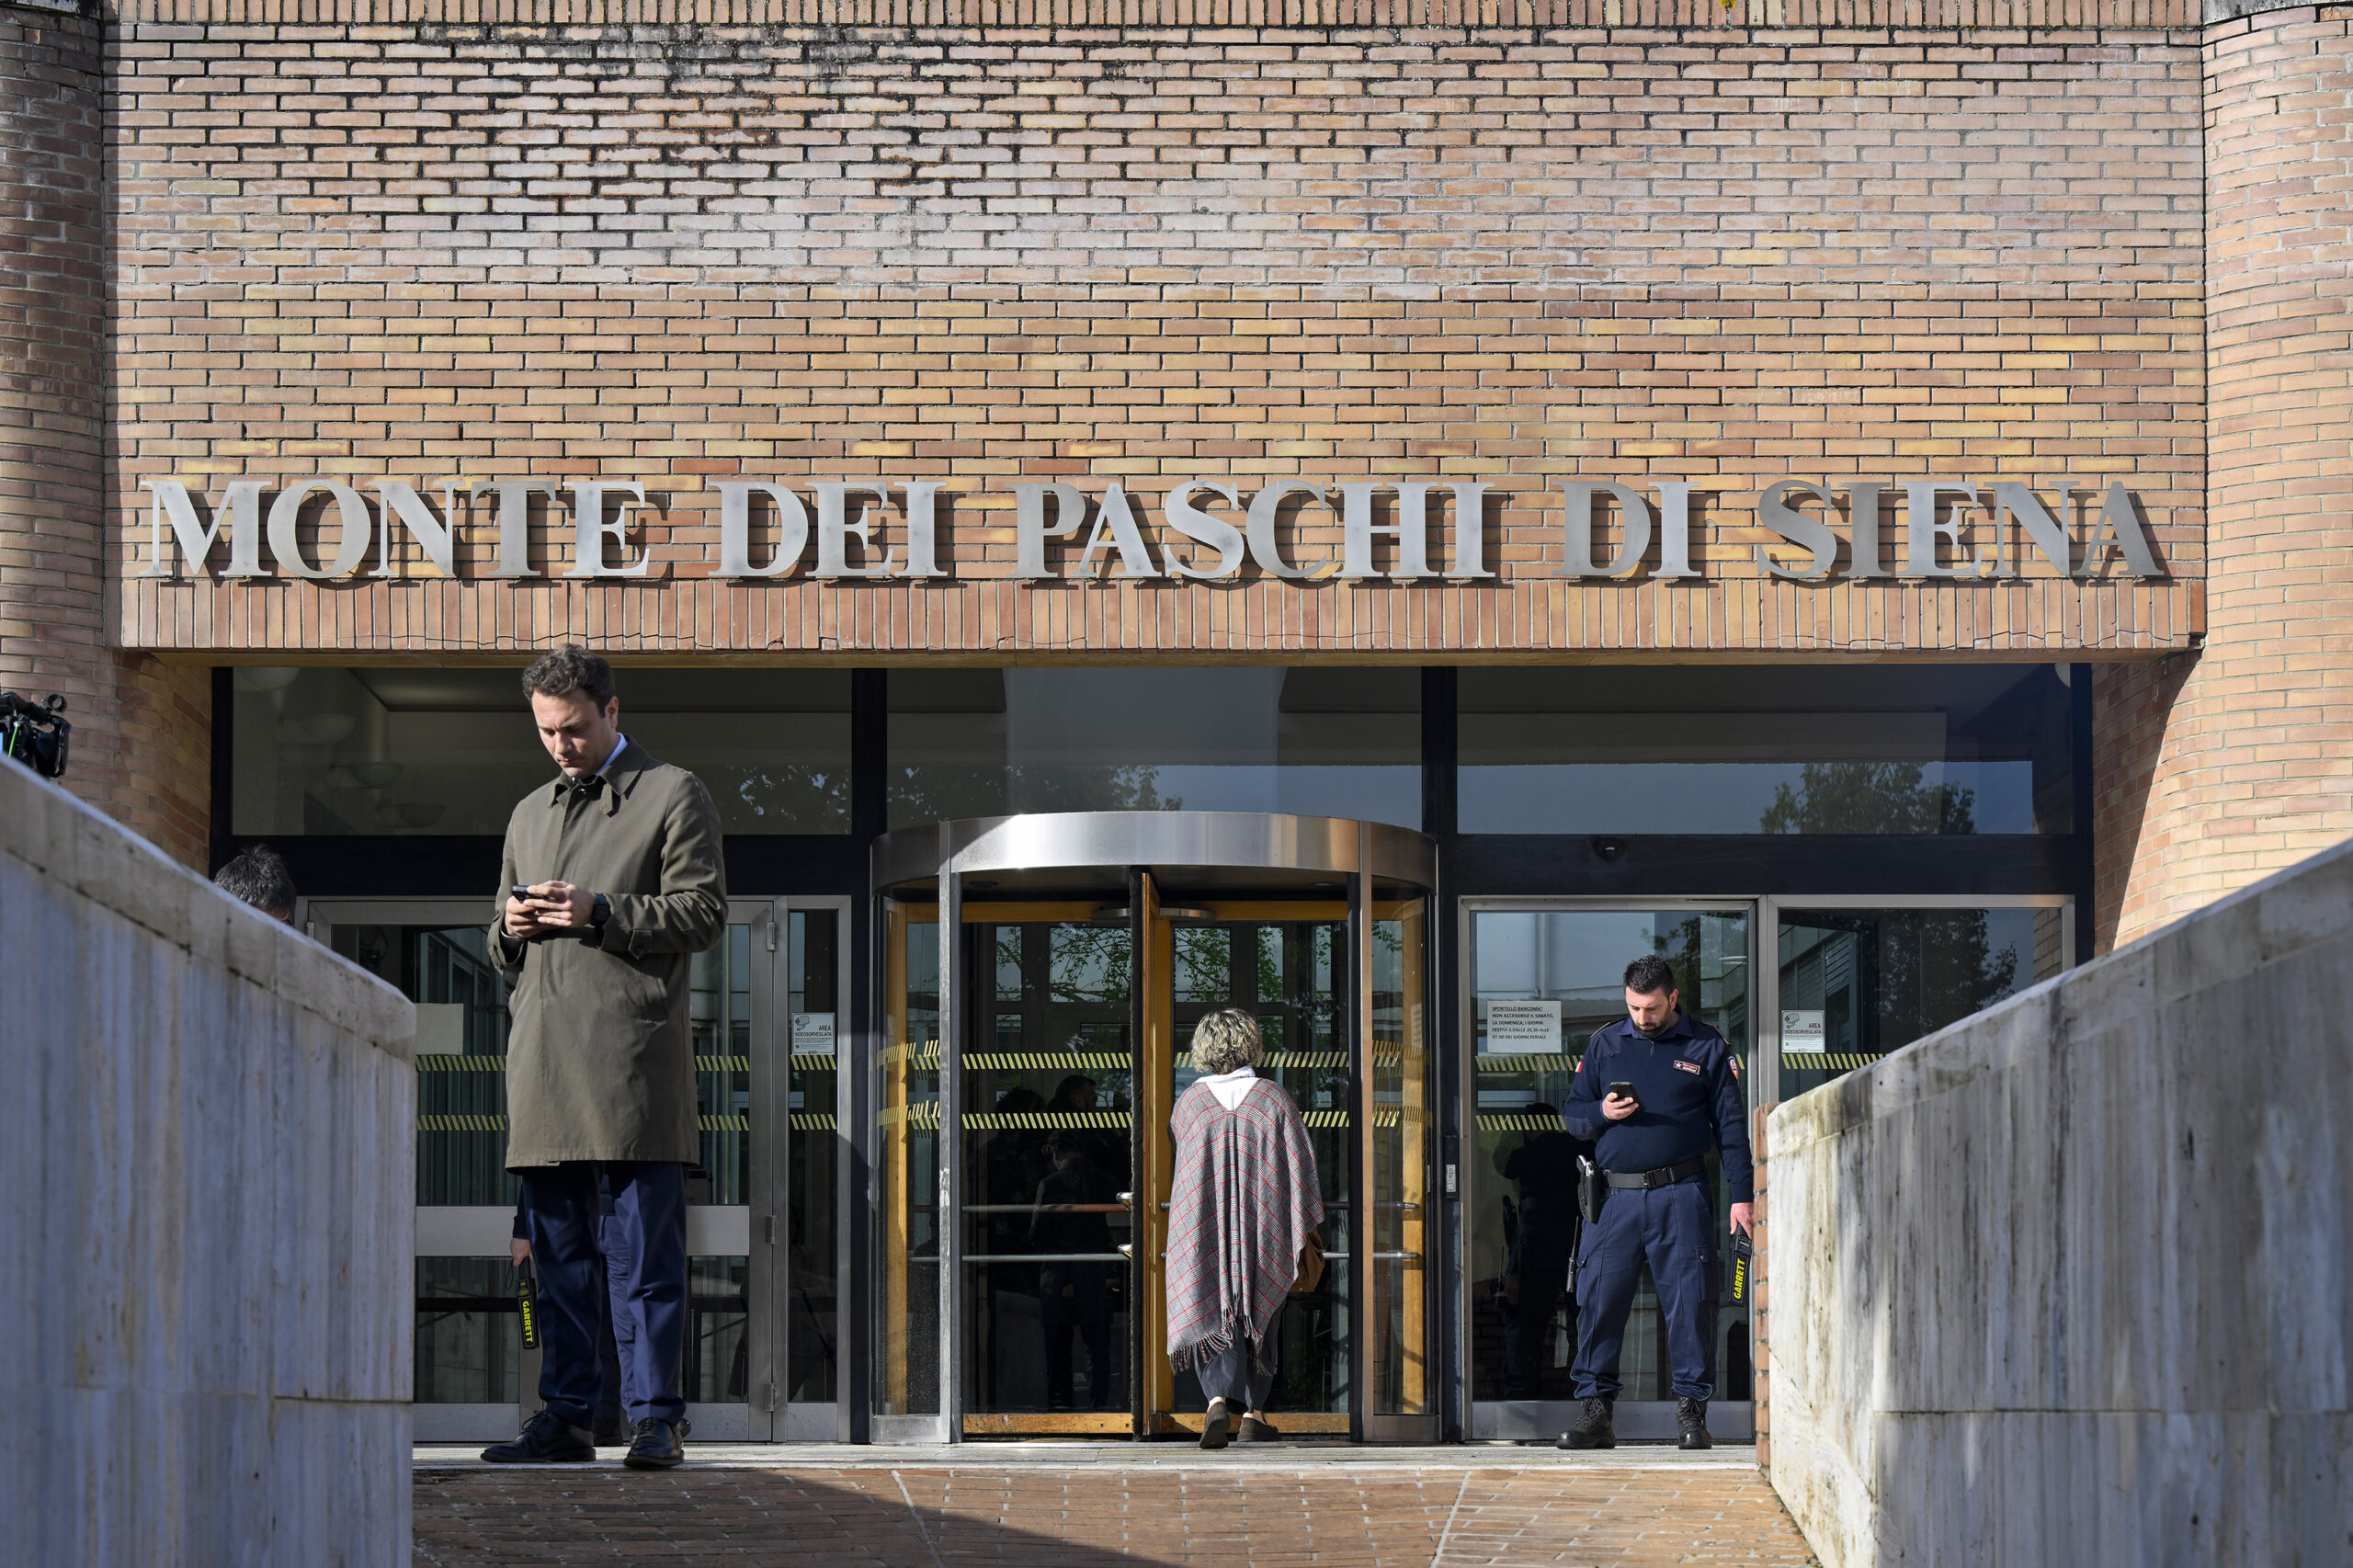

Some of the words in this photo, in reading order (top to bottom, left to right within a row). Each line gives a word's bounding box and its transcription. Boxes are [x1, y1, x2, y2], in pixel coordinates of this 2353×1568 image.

[139, 479, 650, 579] MONTE
[708, 480, 949, 577] DEI
[1004, 479, 1495, 579] PASCHI
[1551, 480, 1702, 578] DI
[1756, 479, 2165, 580] SIENA
[1733, 1258, 1745, 1300] GARRETT
[522, 1301, 533, 1343] GARRETT
